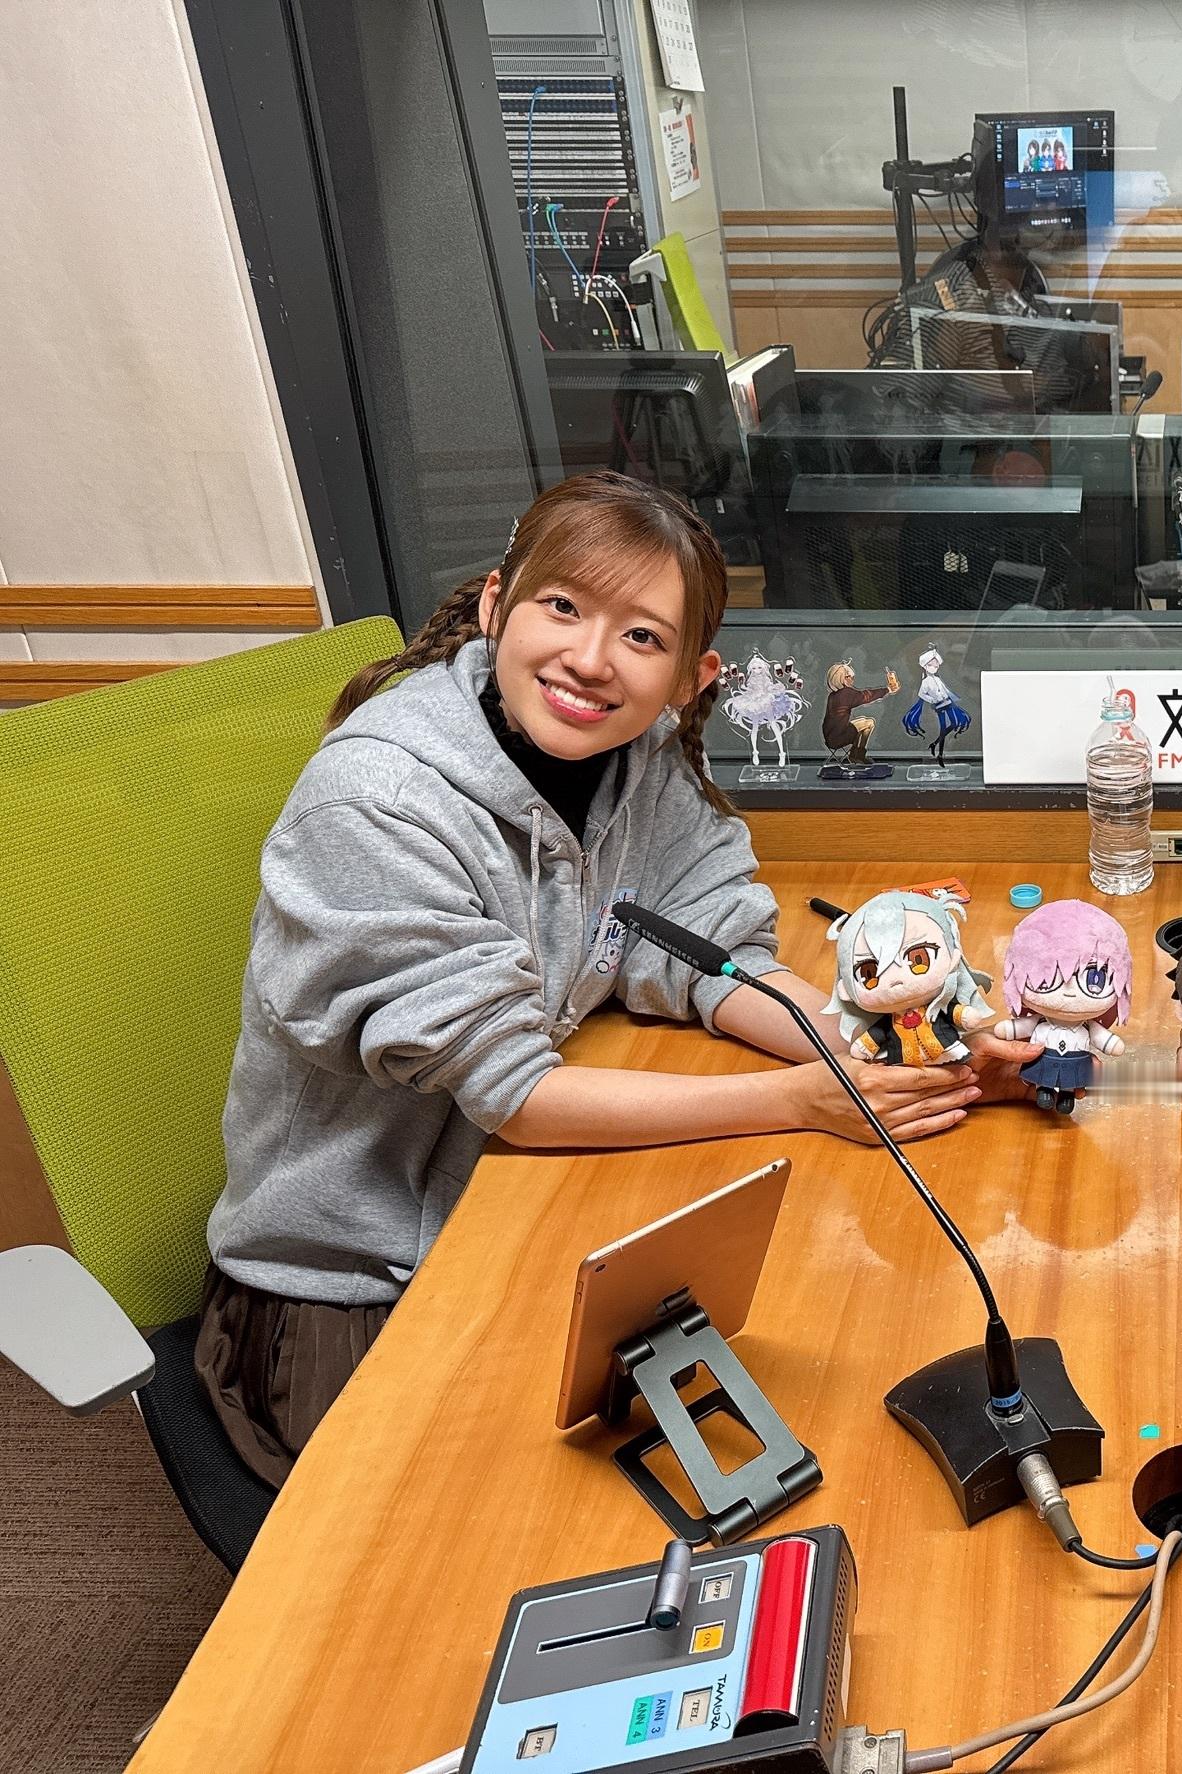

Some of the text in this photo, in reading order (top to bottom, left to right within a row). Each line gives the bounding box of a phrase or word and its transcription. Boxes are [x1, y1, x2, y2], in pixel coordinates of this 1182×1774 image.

[713, 1581, 722, 1598] OFF
[703, 1632, 712, 1648] ON
[651, 1698, 667, 1735] ANN 3
[689, 1699, 701, 1722] TEL
[709, 1673, 727, 1731] TAMURA
[632, 1702, 646, 1739] ANN 4
